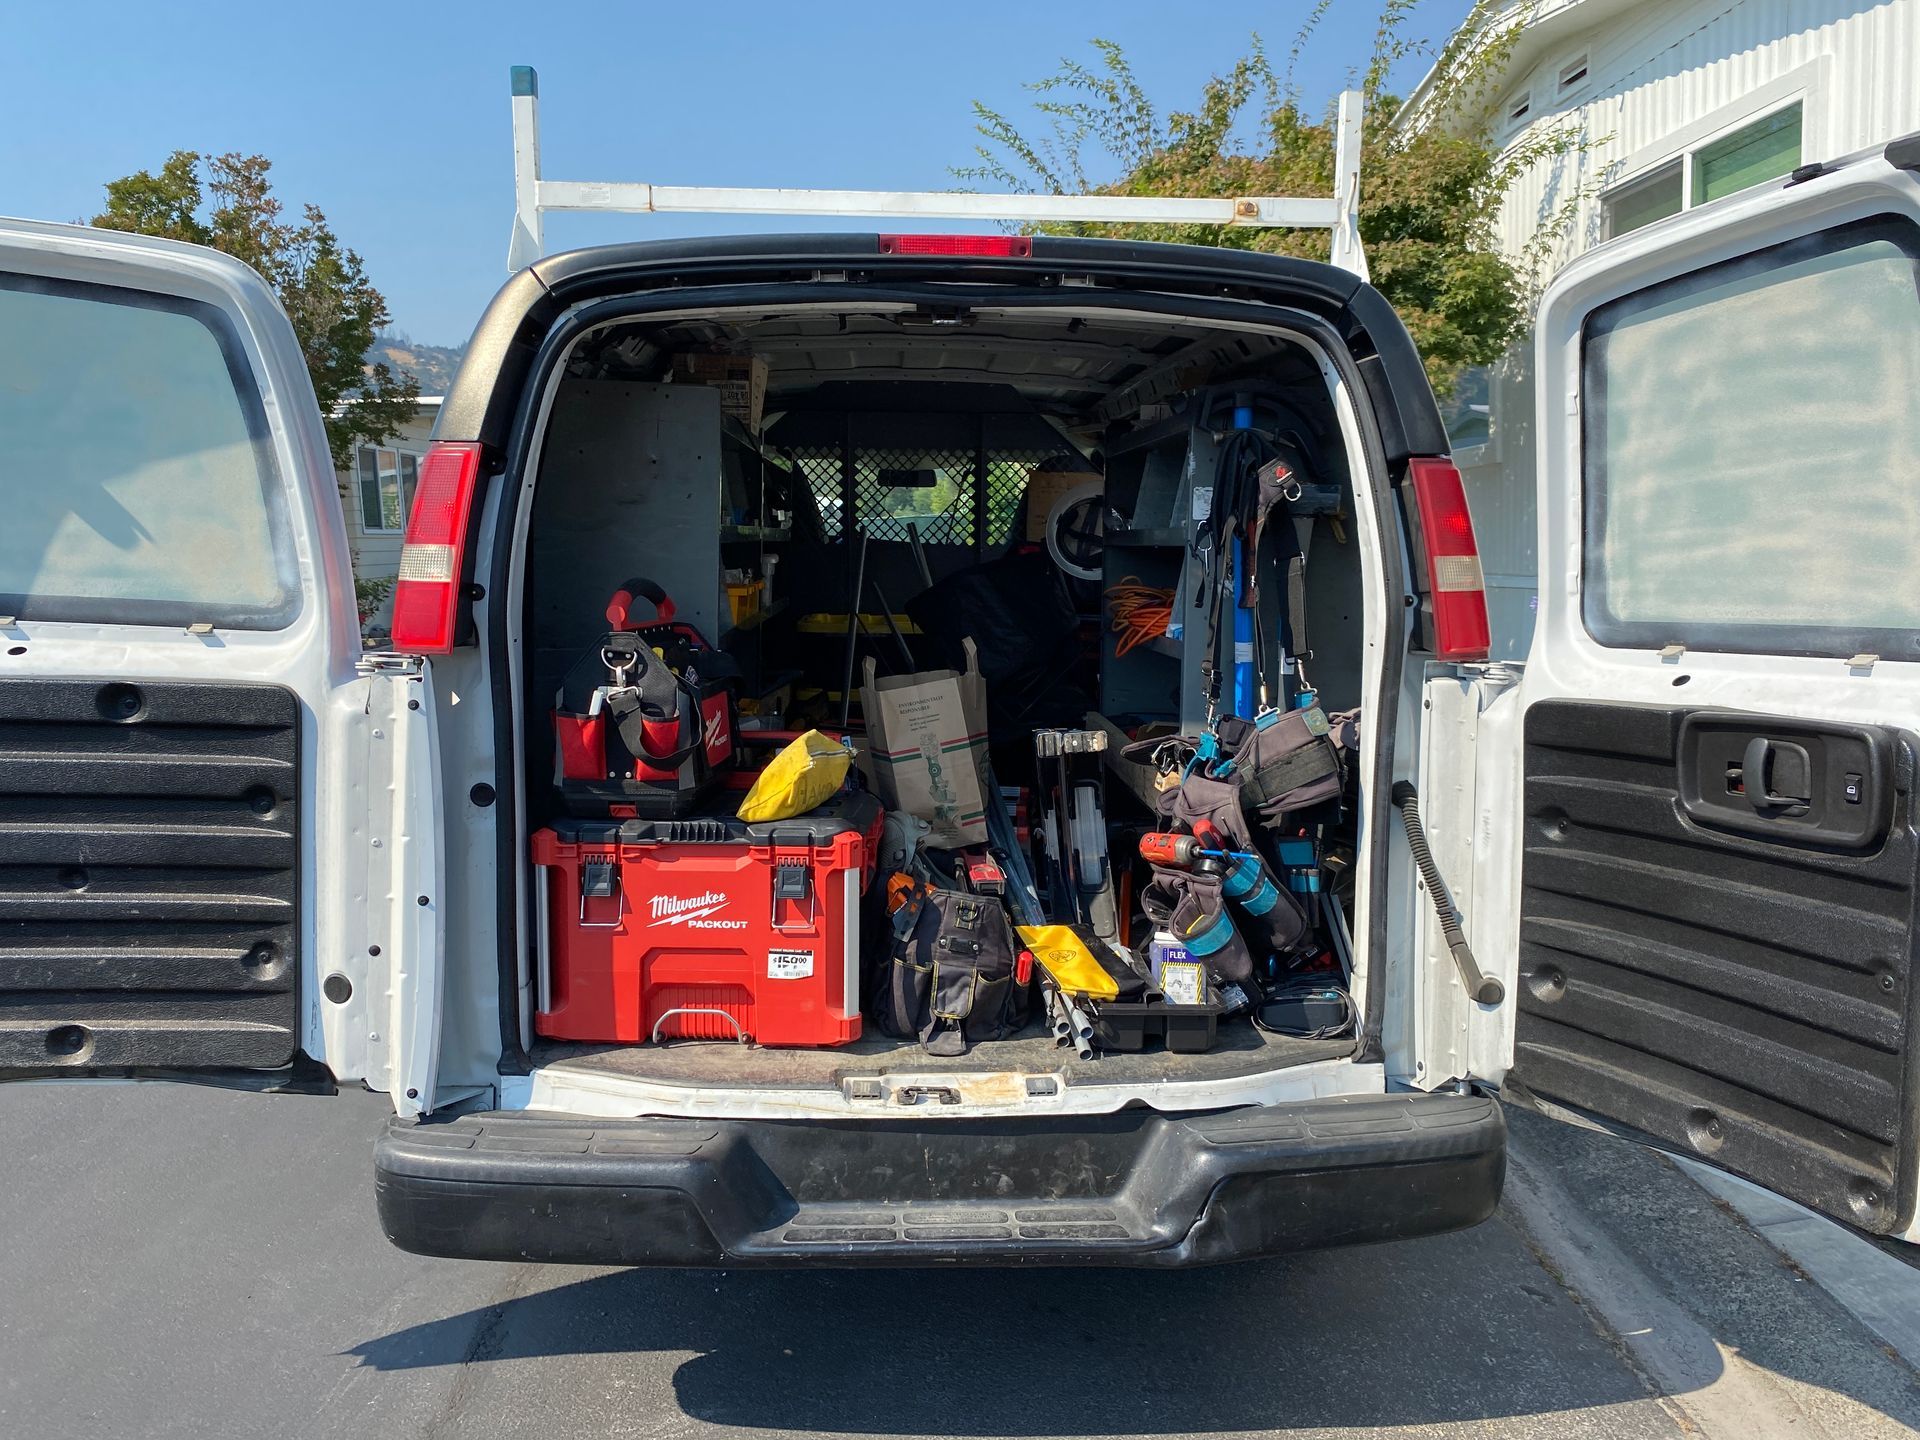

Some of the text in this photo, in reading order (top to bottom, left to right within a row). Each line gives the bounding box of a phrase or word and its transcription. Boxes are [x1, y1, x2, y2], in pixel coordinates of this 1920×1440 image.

[646, 890, 727, 919] Milwaukee
[687, 920, 748, 929] PACKOUT
[1169, 951, 1187, 959] FLEX
